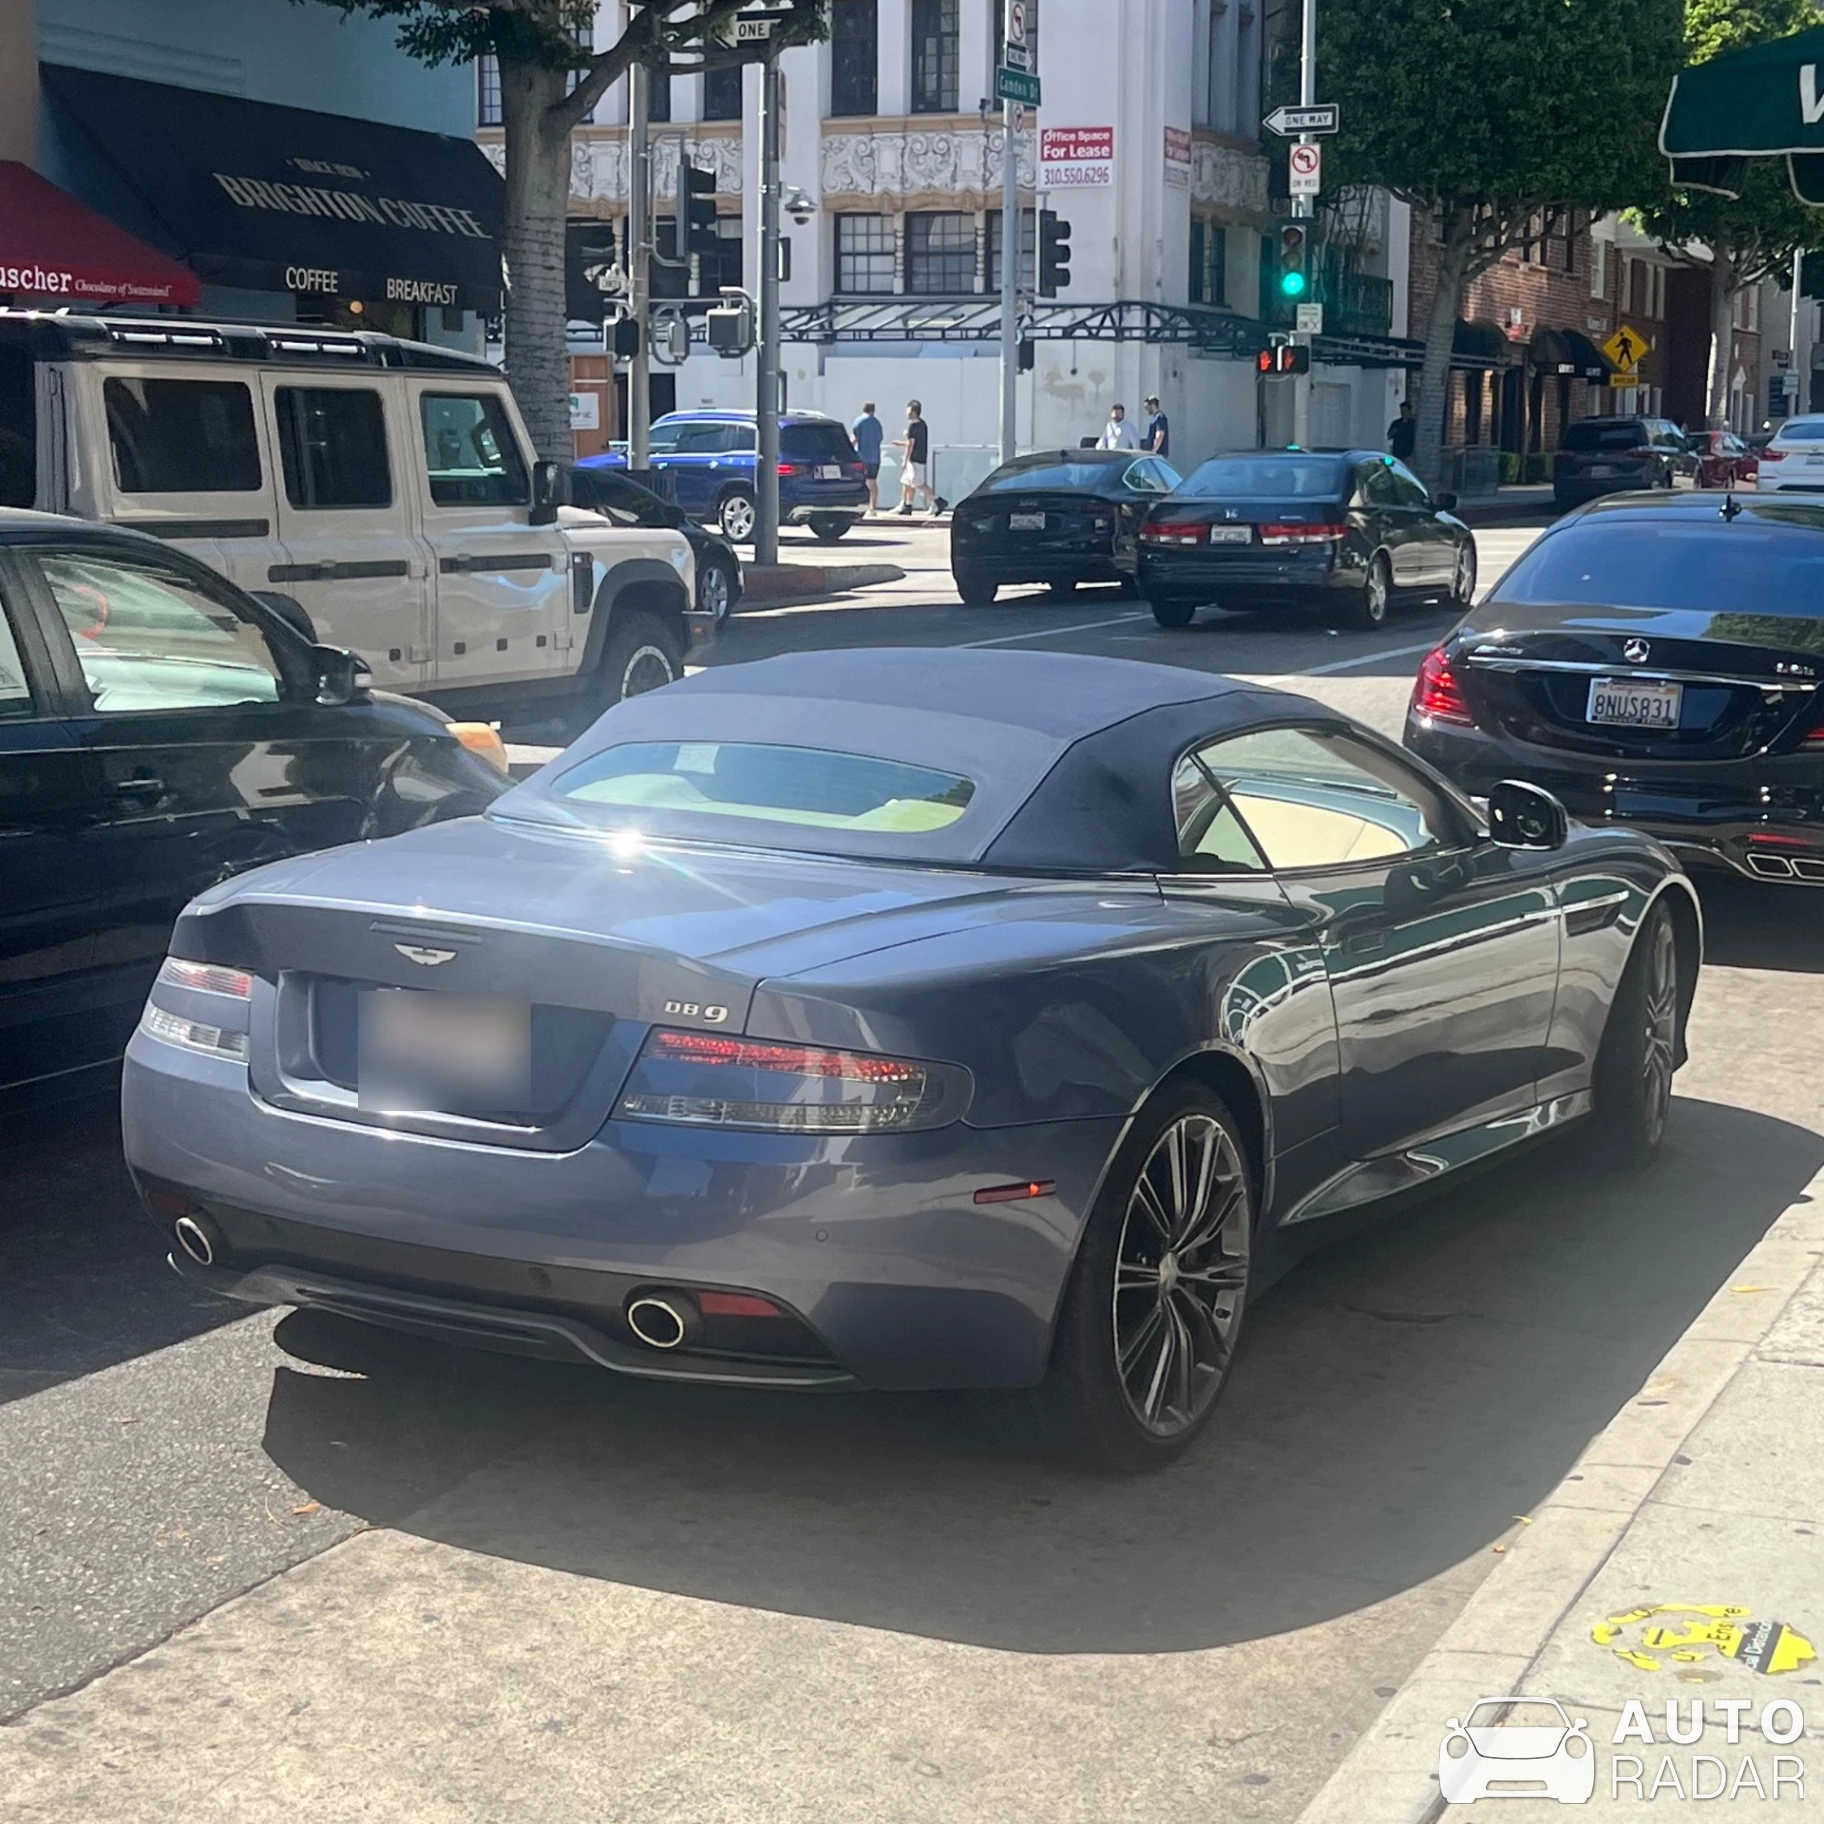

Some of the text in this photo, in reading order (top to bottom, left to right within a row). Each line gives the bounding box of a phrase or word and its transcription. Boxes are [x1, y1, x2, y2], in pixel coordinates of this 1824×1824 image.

[739, 23, 765, 37] ONE
[1285, 114, 1329, 126] ONE WAY
[1043, 130, 1110, 143] Office Space
[1043, 143, 1110, 159] For Lease
[1044, 167, 1109, 185] 310.550.6296
[212, 172, 493, 239] BRIGHTON COFFEE
[286, 266, 338, 293] COFFEE
[117, 283, 127, 297] of
[387, 278, 457, 305] BREAKFAST
[1594, 695, 1671, 719] 8NUS831
[664, 1000, 728, 1023] DB9
